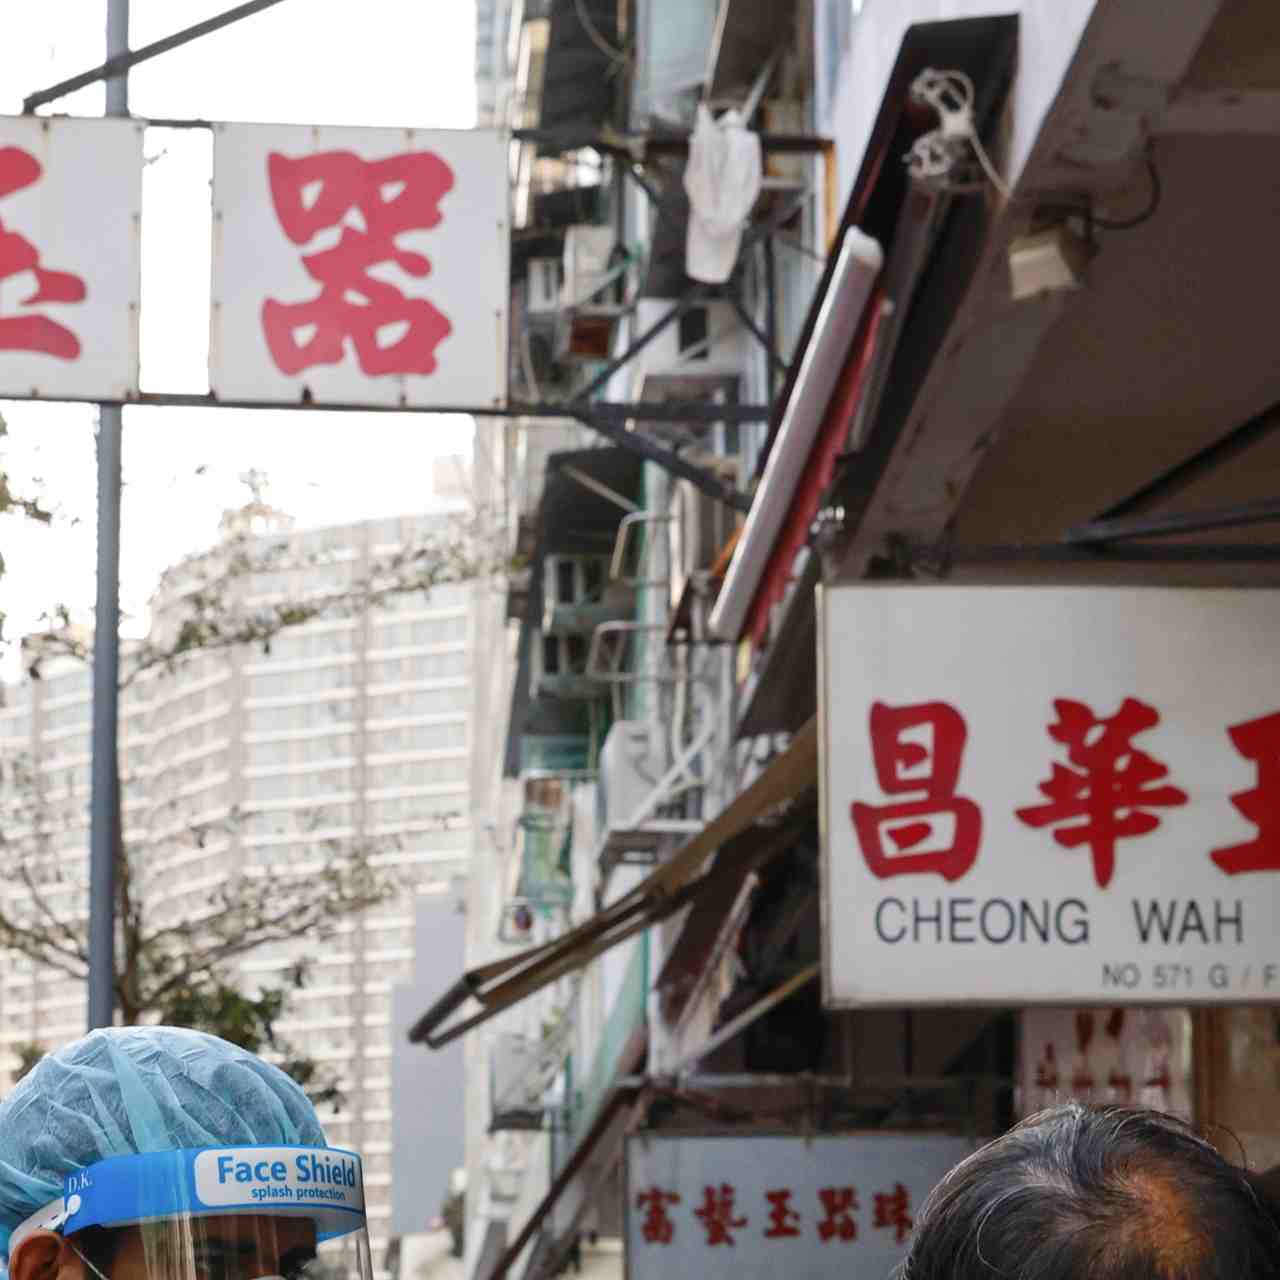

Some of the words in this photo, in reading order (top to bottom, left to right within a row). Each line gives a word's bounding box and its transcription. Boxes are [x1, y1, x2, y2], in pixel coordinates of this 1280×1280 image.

[874, 897, 1090, 947] CHEONG
[1130, 898, 1244, 946] WAH
[1101, 963, 1141, 990] NO
[1153, 963, 1192, 989] 571
[217, 1156, 288, 1184] Face
[296, 1154, 355, 1188] Shield
[251, 1186, 293, 1200] splash
[297, 1186, 346, 1201] protection
